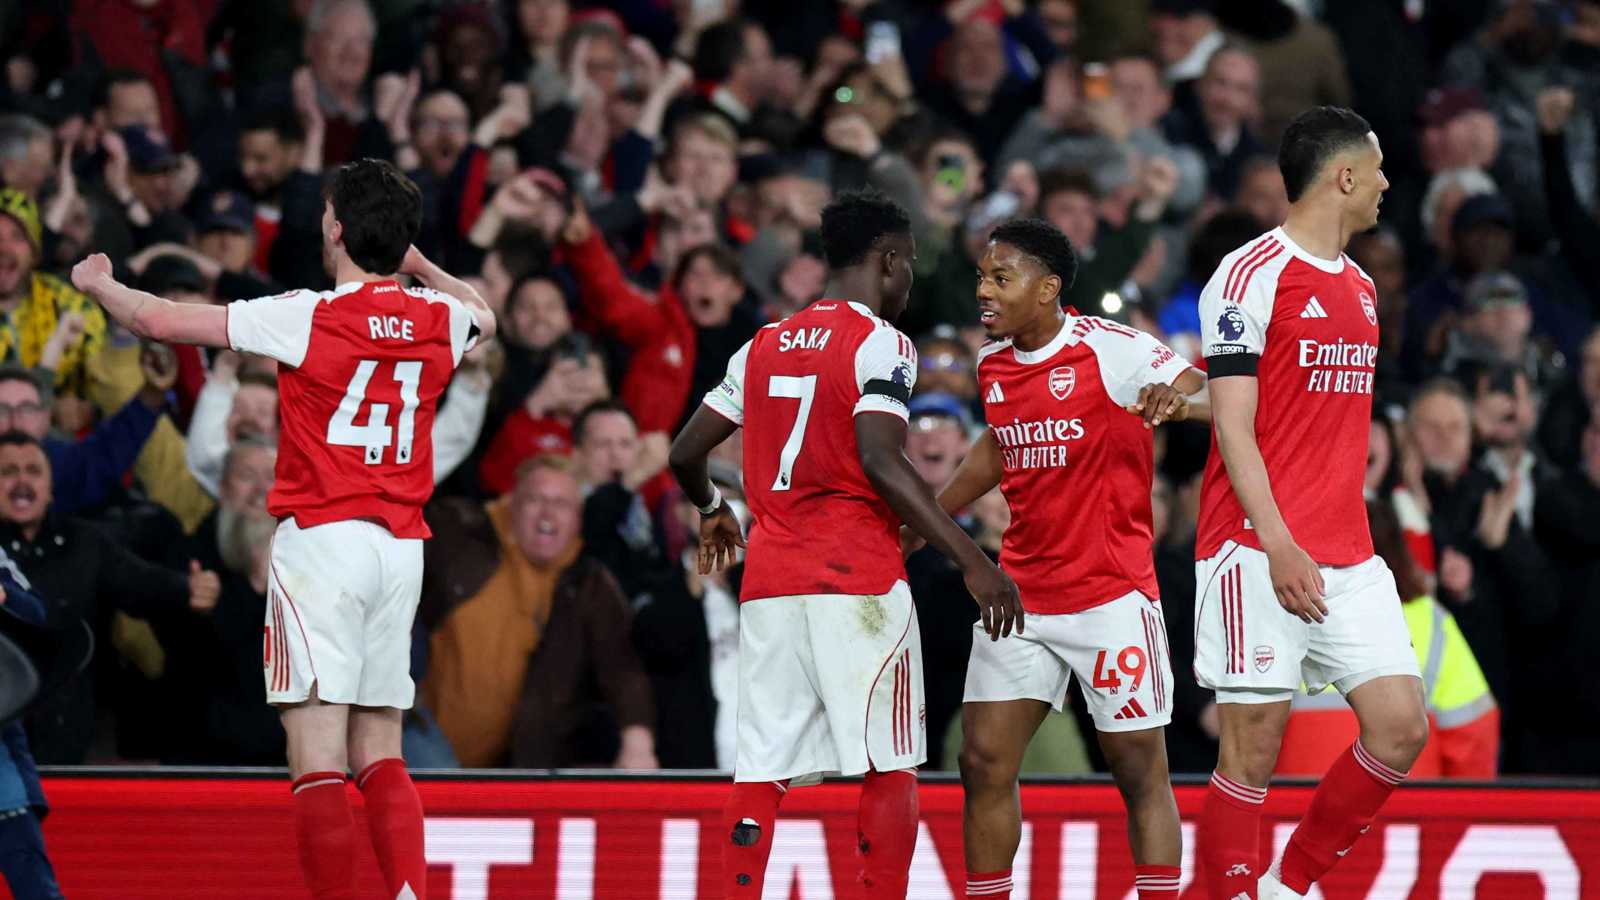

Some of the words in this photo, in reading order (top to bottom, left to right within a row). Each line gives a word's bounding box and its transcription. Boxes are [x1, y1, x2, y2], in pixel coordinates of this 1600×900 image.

[368, 316, 414, 341] RICE
[778, 327, 832, 352] SAKA
[1222, 345, 1244, 353] room
[1298, 337, 1378, 368] Emirate
[1308, 369, 1332, 392] FLY
[1334, 370, 1373, 394] BETTER
[326, 360, 423, 464] 41
[768, 375, 817, 491] 7
[988, 416, 1085, 446] mirates
[1022, 445, 1067, 469] BETTER
[1092, 646, 1147, 695] 49
